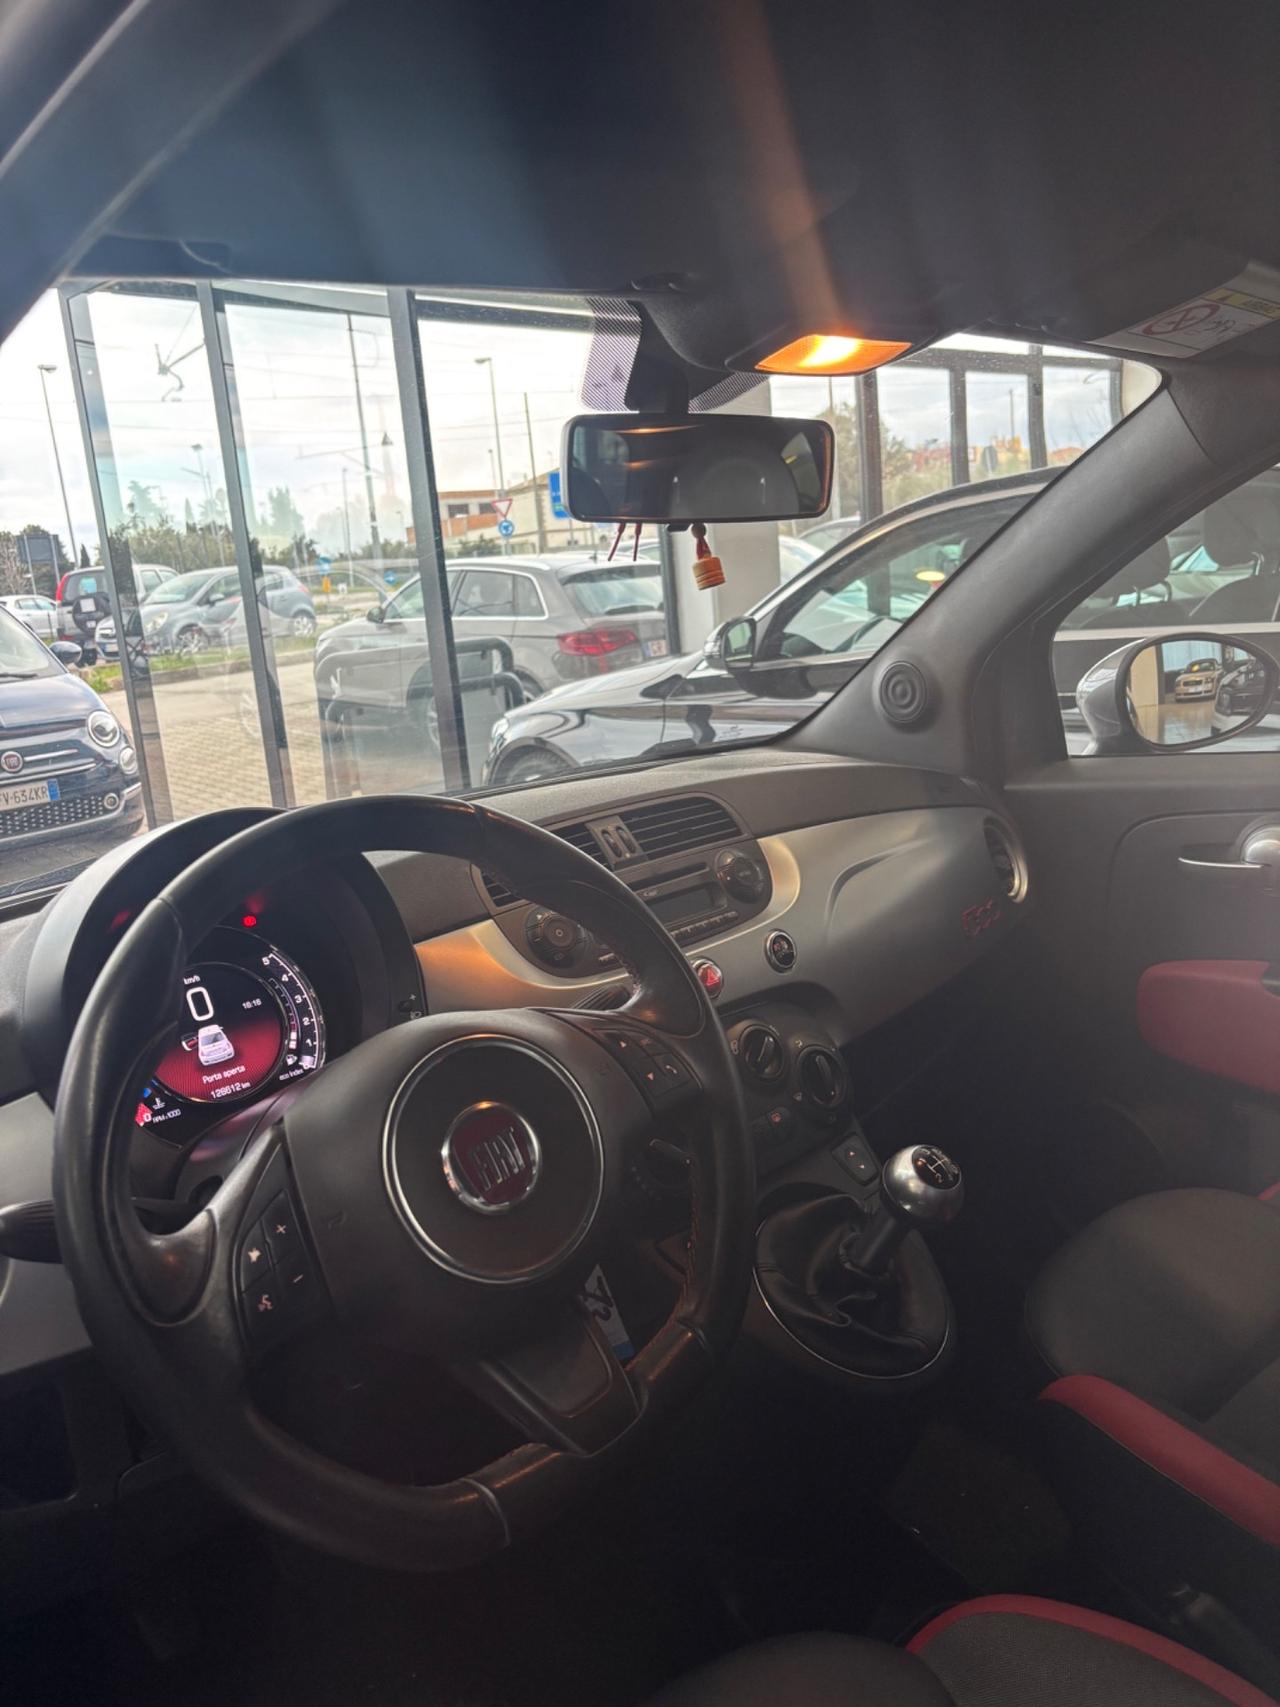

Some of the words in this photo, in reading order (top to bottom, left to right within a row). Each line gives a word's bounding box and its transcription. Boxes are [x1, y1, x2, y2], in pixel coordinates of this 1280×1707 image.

[262, 957, 271, 966] 5
[183, 975, 201, 985] km/h
[281, 974, 290, 982] 4
[186, 986, 214, 1022] 0
[295, 995, 302, 1004] 3
[303, 1017, 311, 1026] 2
[306, 1039, 312, 1047] 1
[202, 1072, 223, 1084] Porta
[223, 1065, 246, 1079] aperta
